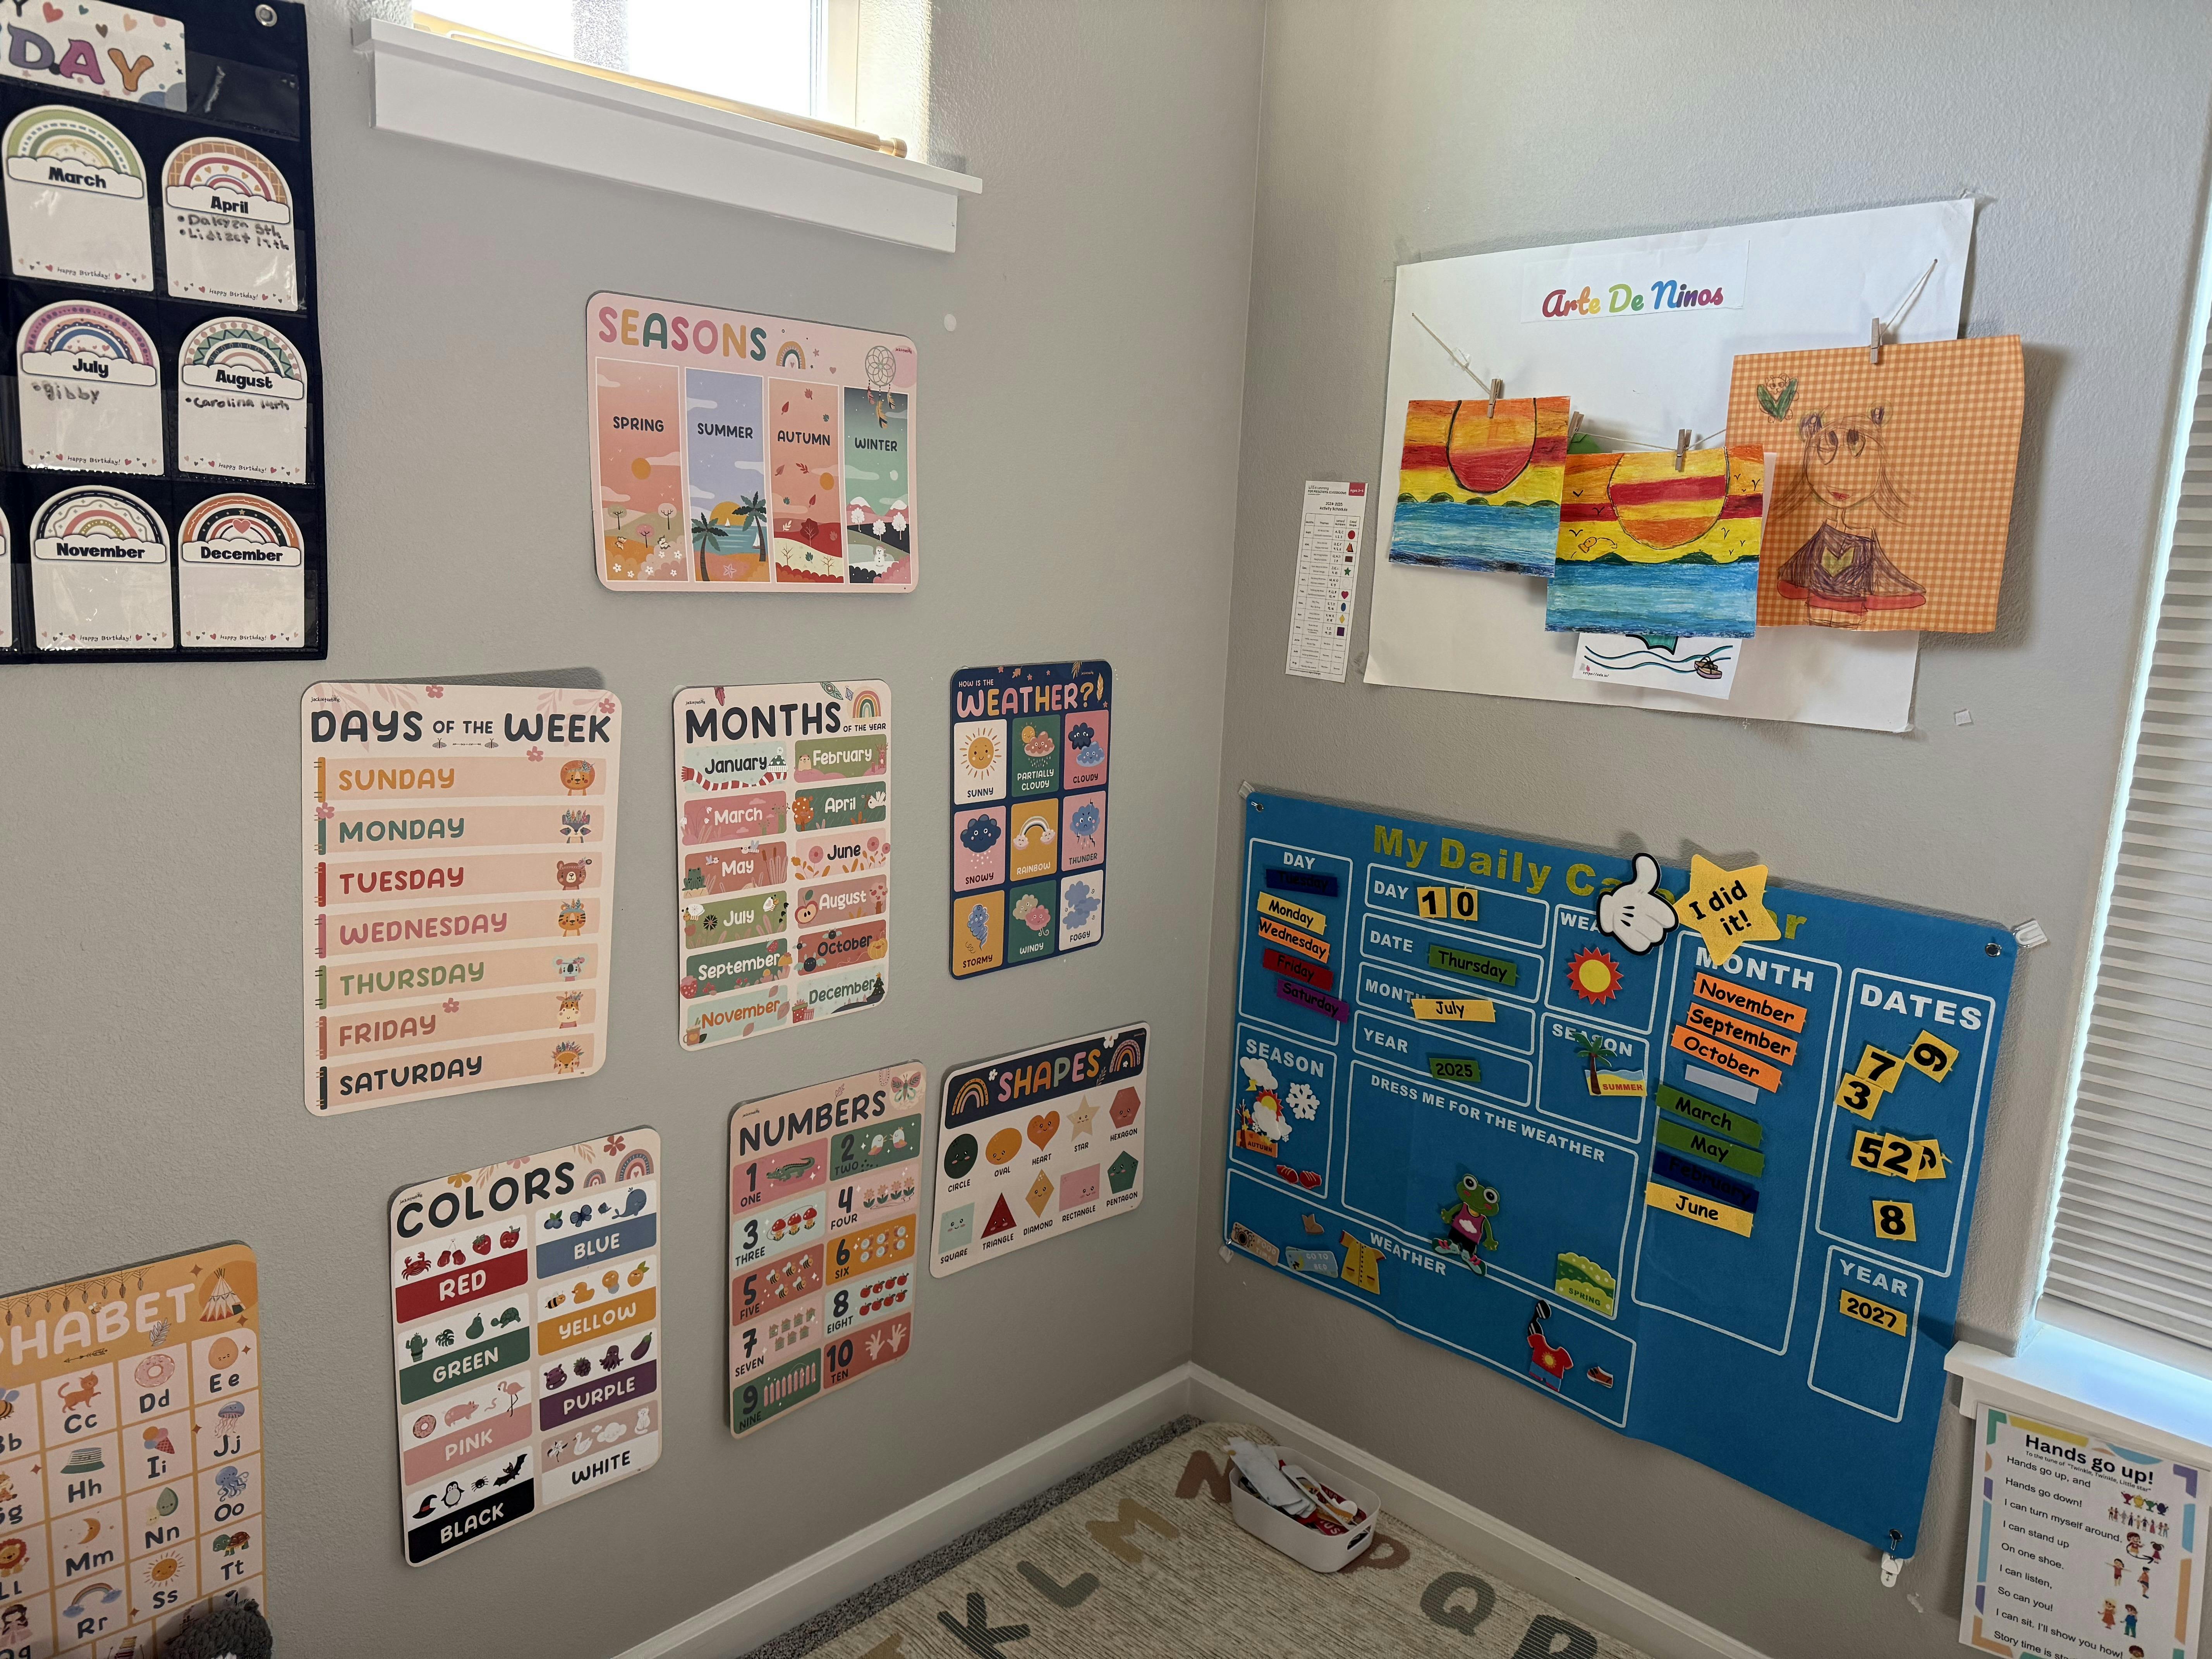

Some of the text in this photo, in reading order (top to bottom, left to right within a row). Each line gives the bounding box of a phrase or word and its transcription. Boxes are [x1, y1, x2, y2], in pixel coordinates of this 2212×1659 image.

[48, 167, 107, 189] March
[211, 196, 249, 214] April
[210, 289, 258, 300] Happy Birthday!
[1542, 280, 1724, 318] Arte De Ninos
[598, 306, 767, 361] SEASONS
[73, 358, 109, 378] July
[215, 369, 273, 389] August
[613, 416, 664, 433] SPRING
[697, 422, 754, 440] SUMMER
[777, 430, 831, 446] AUTUMN
[855, 437, 898, 452] WINTER
[57, 543, 145, 559] November
[201, 546, 283, 562] December
[957, 682, 1094, 718] WEATHER?
[311, 710, 611, 744] DAYS OF THE WEEK
[685, 702, 841, 744] MONTHS
[705, 756, 767, 775] January
[813, 748, 872, 766] February
[338, 768, 455, 792] SUNDAY
[1017, 768, 1054, 781] PARTIALLY
[1022, 780, 1049, 791] CLOUDY
[1073, 773, 1099, 783] CLOUDY
[967, 787, 994, 798] SUNNY
[714, 807, 763, 826] March
[825, 797, 856, 814] April
[339, 817, 465, 843] MONDAY
[827, 844, 861, 860] June
[1069, 853, 1098, 865] THUNDER
[1283, 852, 1316, 870] DAY
[1374, 824, 1550, 895] My Daily
[722, 859, 754, 877] May
[965, 872, 994, 884] SNOWY
[1017, 862, 1051, 875] RAINBOW
[339, 866, 465, 894] TUESDAY
[1374, 881, 1410, 900] DAY
[819, 890, 867, 910] August
[1689, 901, 1707, 921] I
[1708, 880, 1748, 912] did
[723, 909, 754, 927] July
[1268, 899, 1314, 924] Monday
[1720, 909, 1752, 936] it!
[340, 912, 508, 945] WEDNESDAY
[1070, 931, 1091, 943] FOGGY
[817, 935, 873, 957] October
[1020, 942, 1044, 955] WINDY
[1259, 922, 1327, 960] Wednesday
[1370, 930, 1413, 953] DATE
[698, 952, 780, 981] September
[963, 954, 993, 968] STORMY
[1277, 955, 1315, 982] Friday
[1438, 950, 1508, 982] Thursday
[1696, 947, 1815, 991] MONTH
[340, 962, 484, 996] THURSDAY
[809, 978, 875, 1005] December
[1282, 982, 1340, 1019] Saturday
[1699, 979, 1795, 1024] November
[701, 1000, 780, 1029] November
[1436, 1001, 1465, 1018] July
[1860, 984, 1982, 1030] DATES
[339, 1015, 436, 1047] FRIDAY
[1364, 1028, 1409, 1053] YEAR
[1689, 1009, 1791, 1057] September
[1246, 1039, 1324, 1078] SEASON
[1684, 1036, 1760, 1079] October
[340, 1056, 483, 1096] SATURDAY
[997, 1048, 1101, 1102] SHAPES
[1435, 1063, 1473, 1077] 2025
[1602, 1083, 1644, 1091] SUMMER
[740, 1090, 886, 1156] NUMBERS
[1371, 1075, 1605, 1163] DRESS ME FOR THE WEATHER
[1675, 1097, 1731, 1131] March
[1110, 1128, 1138, 1142] HEXAGON
[1074, 1142, 1089, 1152] STAR
[1248, 1141, 1273, 1153] AUTUMN
[1690, 1135, 1729, 1163] May
[835, 1161, 858, 1176] TWO
[1032, 1153, 1051, 1165] HEART
[994, 1166, 1011, 1177] OVAL
[948, 1179, 971, 1192] CIRCLE
[397, 1162, 575, 1238] COLORS
[740, 1192, 761, 1207] ONE
[1106, 1192, 1138, 1207] PENTAGON
[1675, 1195, 1719, 1221] June
[831, 1213, 858, 1230] FOUR
[1062, 1205, 1096, 1222] RECTANGLE
[1023, 1219, 1053, 1235] DIAMOND
[574, 1233, 620, 1261] BLUE
[982, 1233, 1014, 1250] TRIANGLE
[735, 1246, 765, 1266] THREE
[940, 1248, 968, 1264] SQUARE
[1370, 1232, 1447, 1276] WEATHER
[835, 1266, 849, 1279] SIX
[1840, 1259, 1908, 1298] YEAR
[439, 1269, 486, 1301] RED
[1568, 1288, 1601, 1306] SPRING
[559, 1302, 637, 1340] YELLOW
[740, 1303, 760, 1321] FIVE
[1846, 1297, 1897, 1328] 2027
[0, 1283, 195, 1365] HABET
[827, 1316, 854, 1334] EIGHT
[432, 1347, 499, 1383] GREEN
[735, 1355, 764, 1377] SEVEN
[831, 1369, 849, 1384] TEN
[563, 1377, 635, 1415] PURPLE
[739, 1411, 762, 1431] NINE
[445, 1429, 493, 1461] PINK
[571, 1450, 631, 1485] WHITE
[2026, 1434, 2154, 1485] Hands go up!
[2005, 1477, 2083, 1508] Hands go down!
[440, 1503, 505, 1544] BLACK
[2008, 1524, 2025, 1535] can
[2028, 1527, 2054, 1543] stand
[2057, 1538, 2069, 1549] up
[2001, 1542, 2064, 1570] On one shoe.
[1998, 1587, 2053, 1611] So can you!
[2002, 1611, 2019, 1623] can
[2021, 1617, 2034, 1628] sit.
[2038, 1623, 2048, 1633] I'll
[2051, 1627, 2076, 1643] show
[2079, 1638, 2097, 1650] you
[2100, 1644, 2124, 1659] how!
